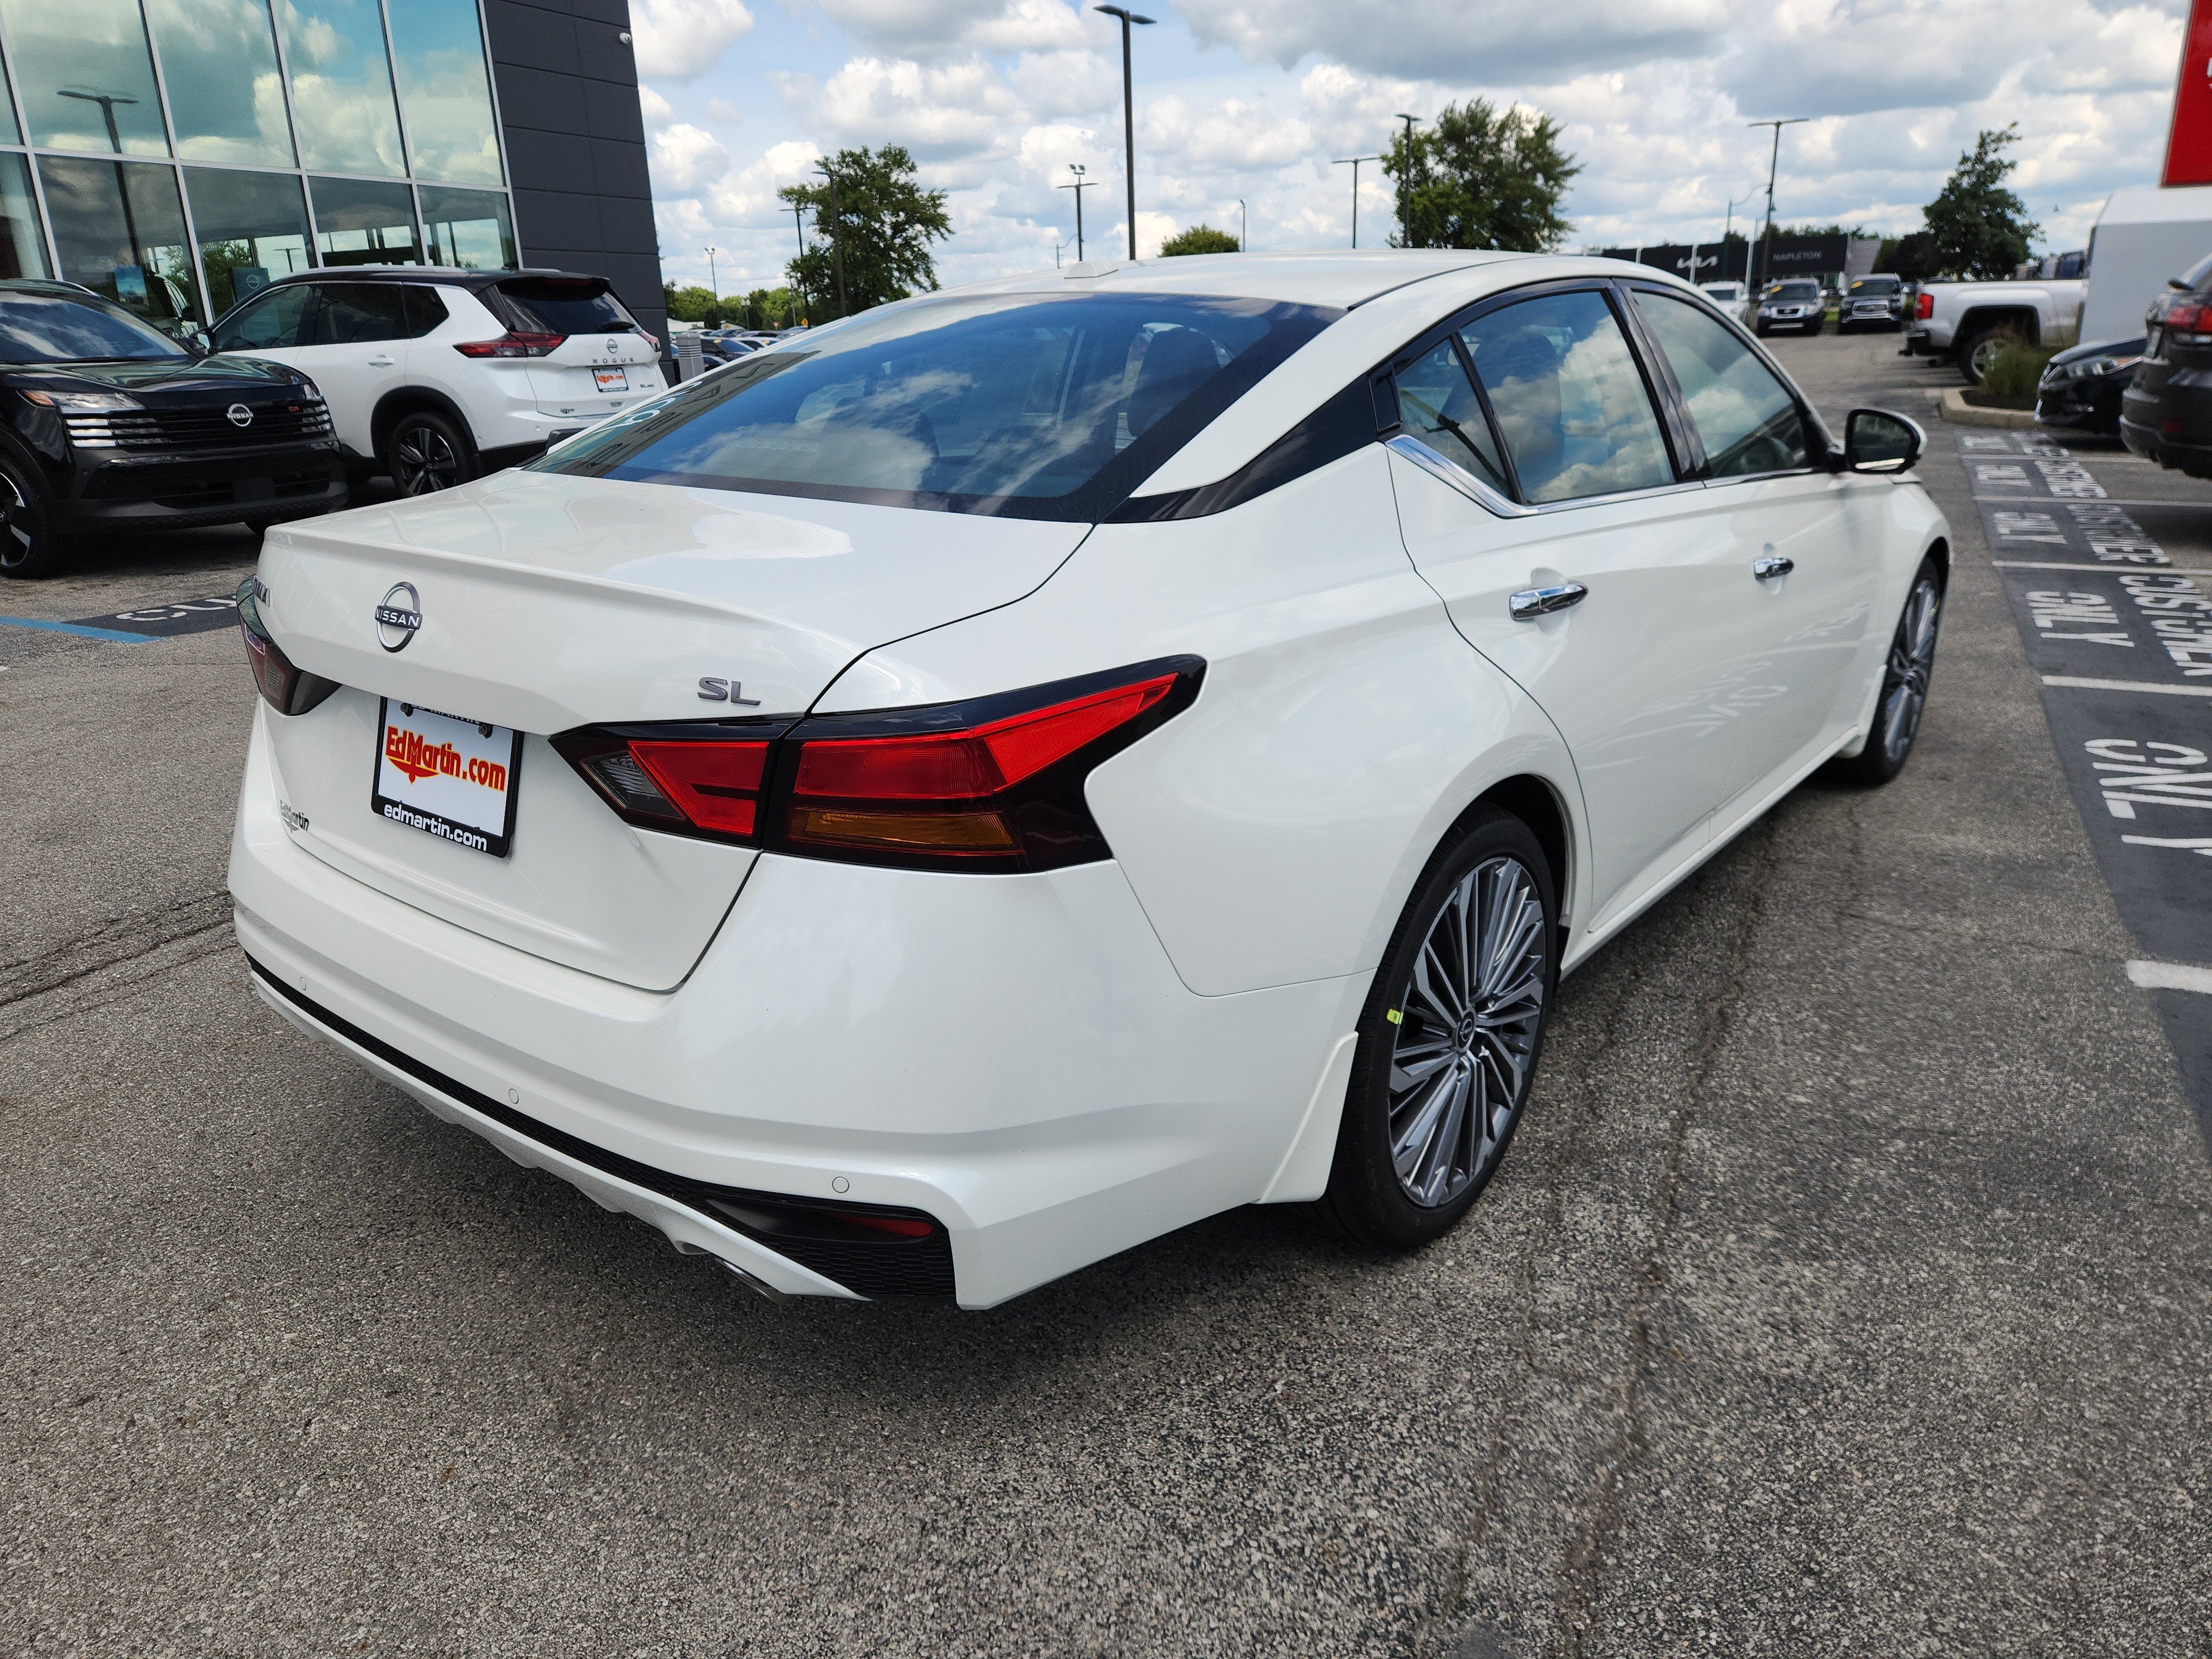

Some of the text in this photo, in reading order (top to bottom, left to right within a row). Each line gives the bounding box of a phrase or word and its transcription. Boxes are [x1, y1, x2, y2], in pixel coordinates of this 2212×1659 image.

[1773, 250, 1823, 261] NAPLETON
[376, 608, 420, 627] NISSAN
[2026, 590, 2136, 648] ONLY
[697, 677, 761, 705] SL
[383, 804, 487, 852] edmartin.com
